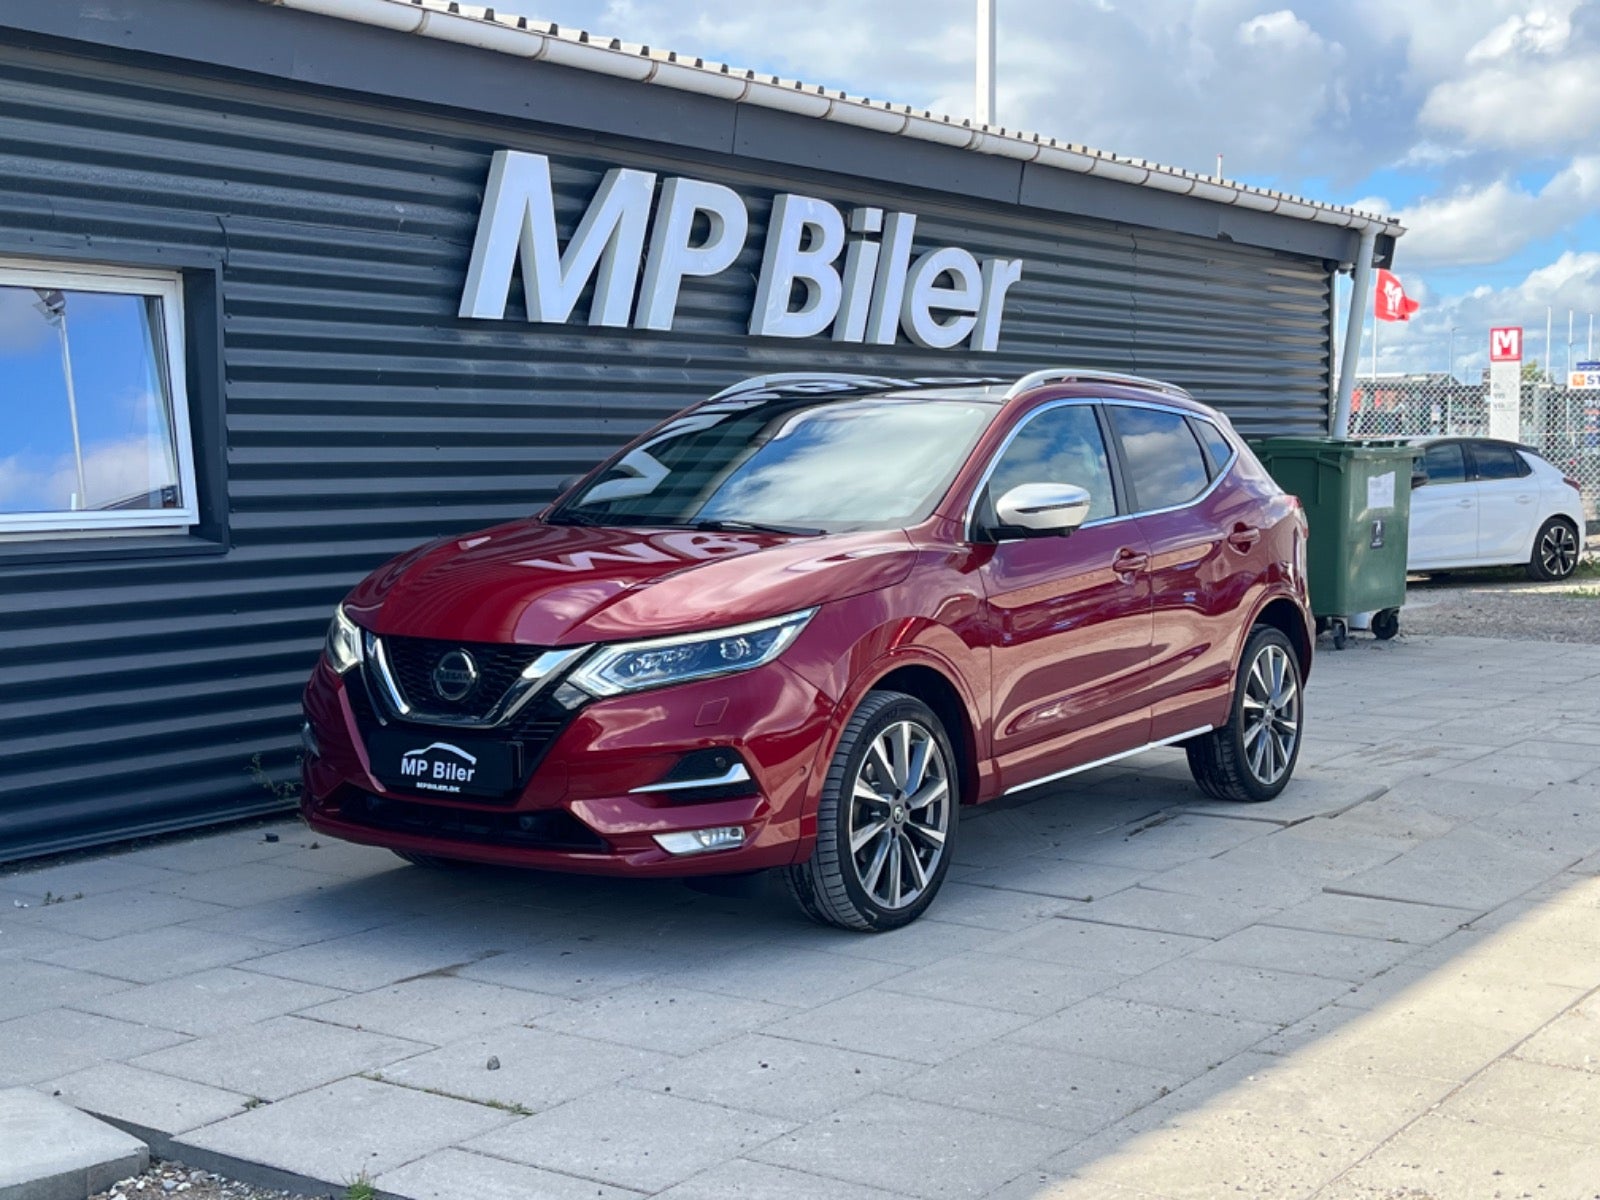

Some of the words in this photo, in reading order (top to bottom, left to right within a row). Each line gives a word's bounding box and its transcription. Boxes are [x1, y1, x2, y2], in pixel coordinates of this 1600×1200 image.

[458, 149, 748, 331] MP
[748, 193, 1022, 352] Biler
[1492, 329, 1519, 356] M
[401, 757, 428, 777] MP
[432, 760, 475, 782] Biler
